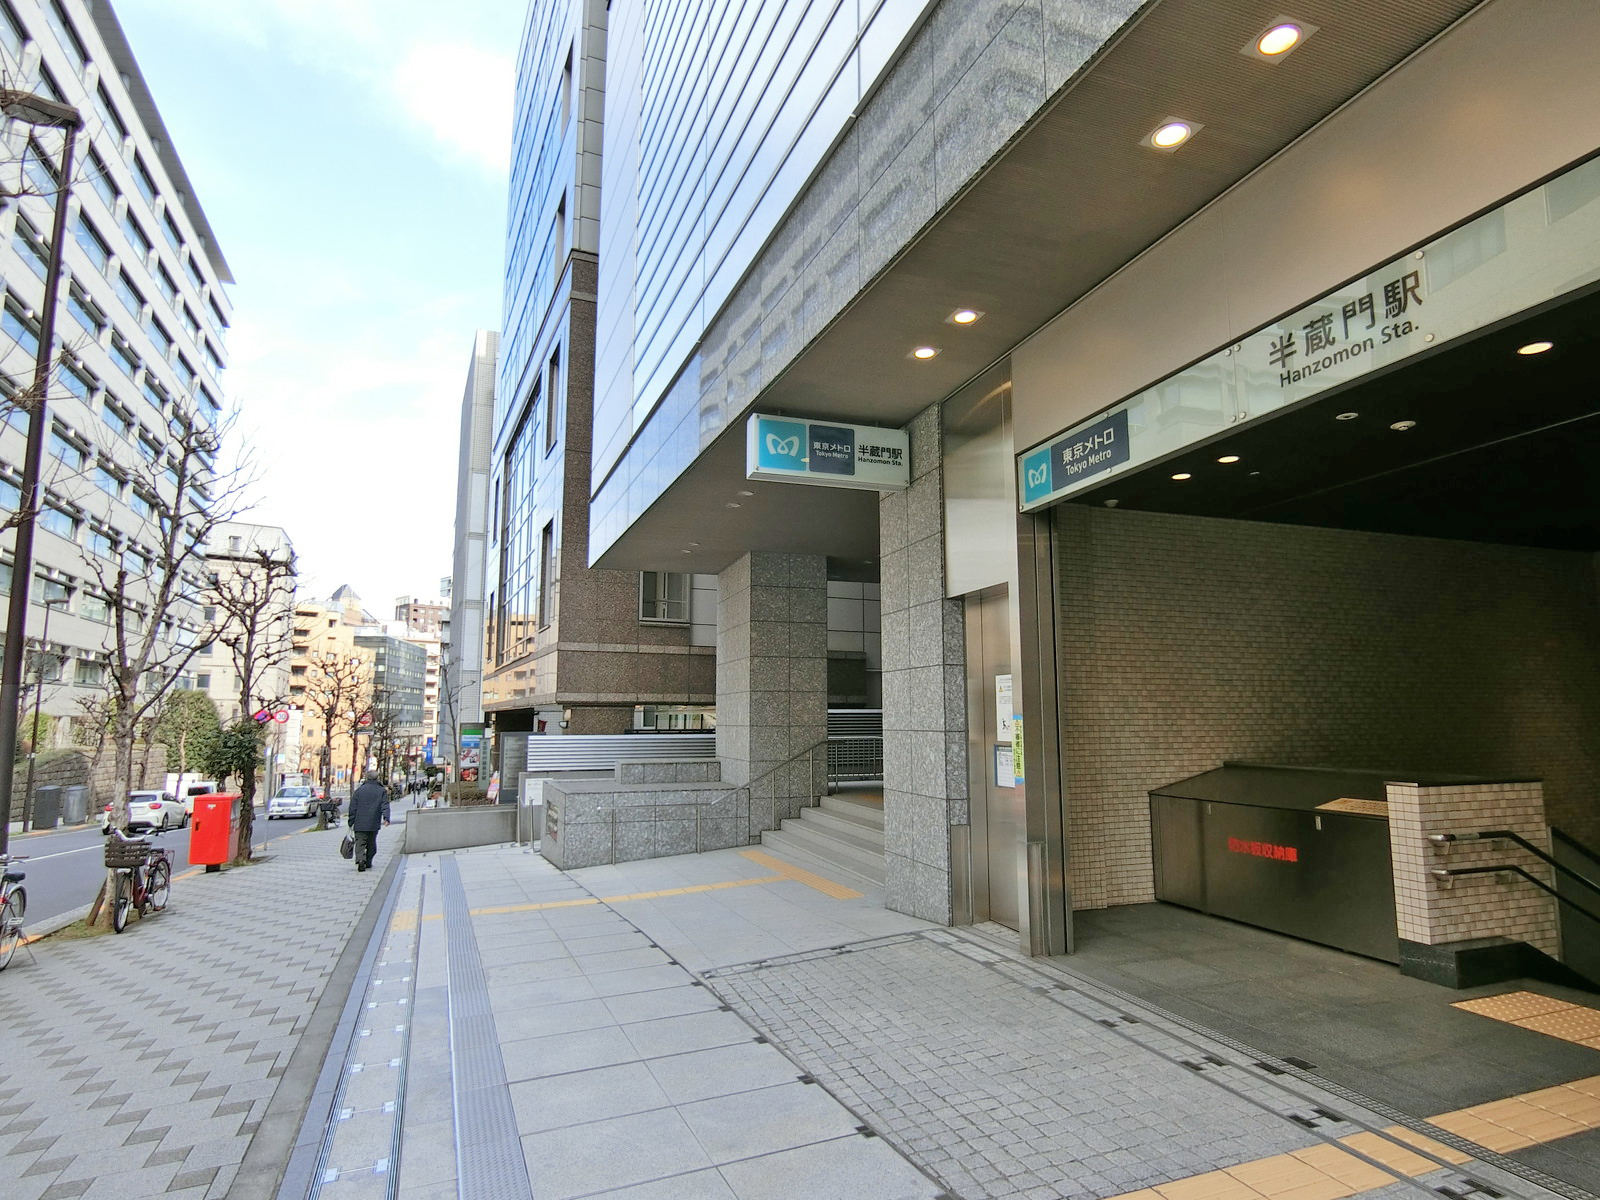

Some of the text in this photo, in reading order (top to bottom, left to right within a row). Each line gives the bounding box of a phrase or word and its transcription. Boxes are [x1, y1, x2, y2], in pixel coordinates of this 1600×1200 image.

[1268, 270, 1423, 369] 半蔵門駅
[1280, 320, 1420, 388] Hanzomon Sta.
[813, 441, 851, 453] 東京メトロ
[816, 451, 832, 459] Tokyo
[858, 444, 903, 460] 半蔵門駅
[1062, 427, 1114, 465] 東京メトロ
[858, 456, 903, 467] Hanzomon Sta.
[1066, 449, 1112, 476] Tokyo Metro
